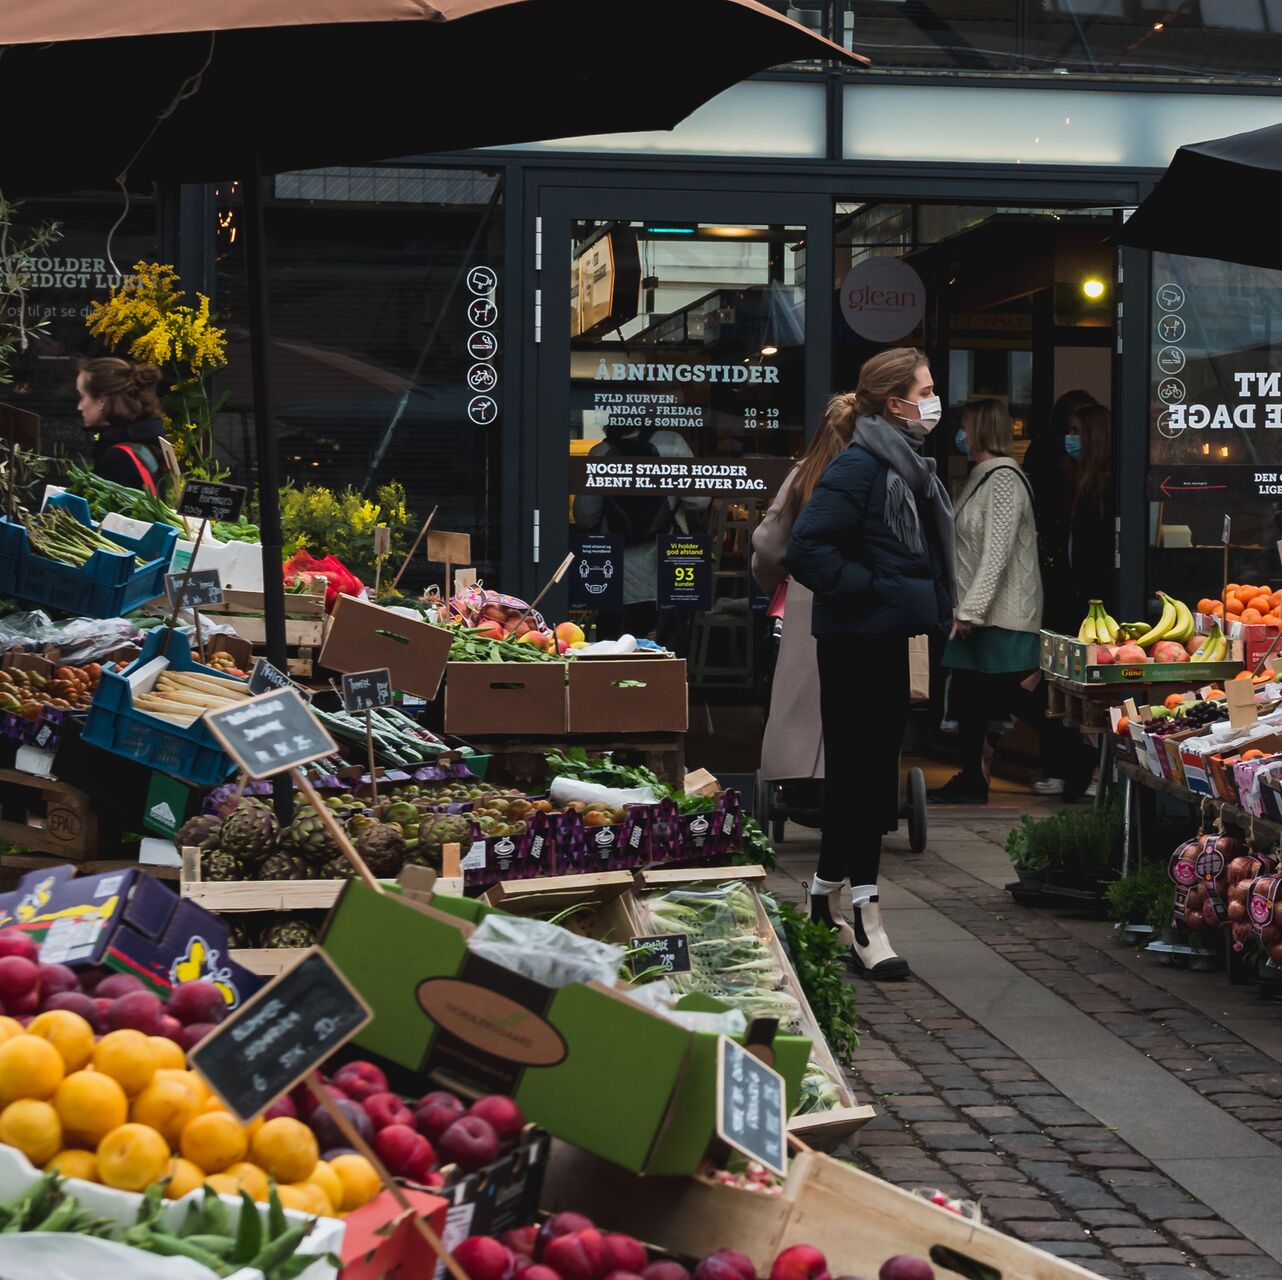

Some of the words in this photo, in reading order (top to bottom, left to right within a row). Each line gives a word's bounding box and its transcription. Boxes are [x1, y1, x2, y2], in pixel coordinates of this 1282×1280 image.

[848, 286, 916, 311] glean
[27, 305, 39, 317] til
[44, 306, 57, 317] at
[61, 307, 75, 317] se
[594, 359, 779, 383] ÅBNINGSTIDER
[594, 394, 623, 403] FYLD
[626, 394, 678, 404] KURVEN:
[594, 405, 646, 415] MANDAG
[656, 406, 702, 416] FREDAG
[744, 408, 757, 417] 10
[767, 408, 779, 417] 19
[645, 417, 652, 427] &
[655, 417, 703, 427] SØNDAG
[744, 420, 757, 429] 10
[767, 420, 779, 429] 18
[586, 463, 633, 475] NOGLE
[636, 464, 689, 475] STADER
[692, 465, 747, 476] HOLDER
[586, 477, 632, 488] ÅBENT
[635, 478, 656, 489] KL.
[660, 478, 691, 489] 11-17
[695, 478, 732, 489] HVER
[735, 479, 767, 490] DAG.
[1254, 473, 1277, 482] DEN
[1259, 485, 1282, 495] LIGE
[675, 567, 695, 581] 93
